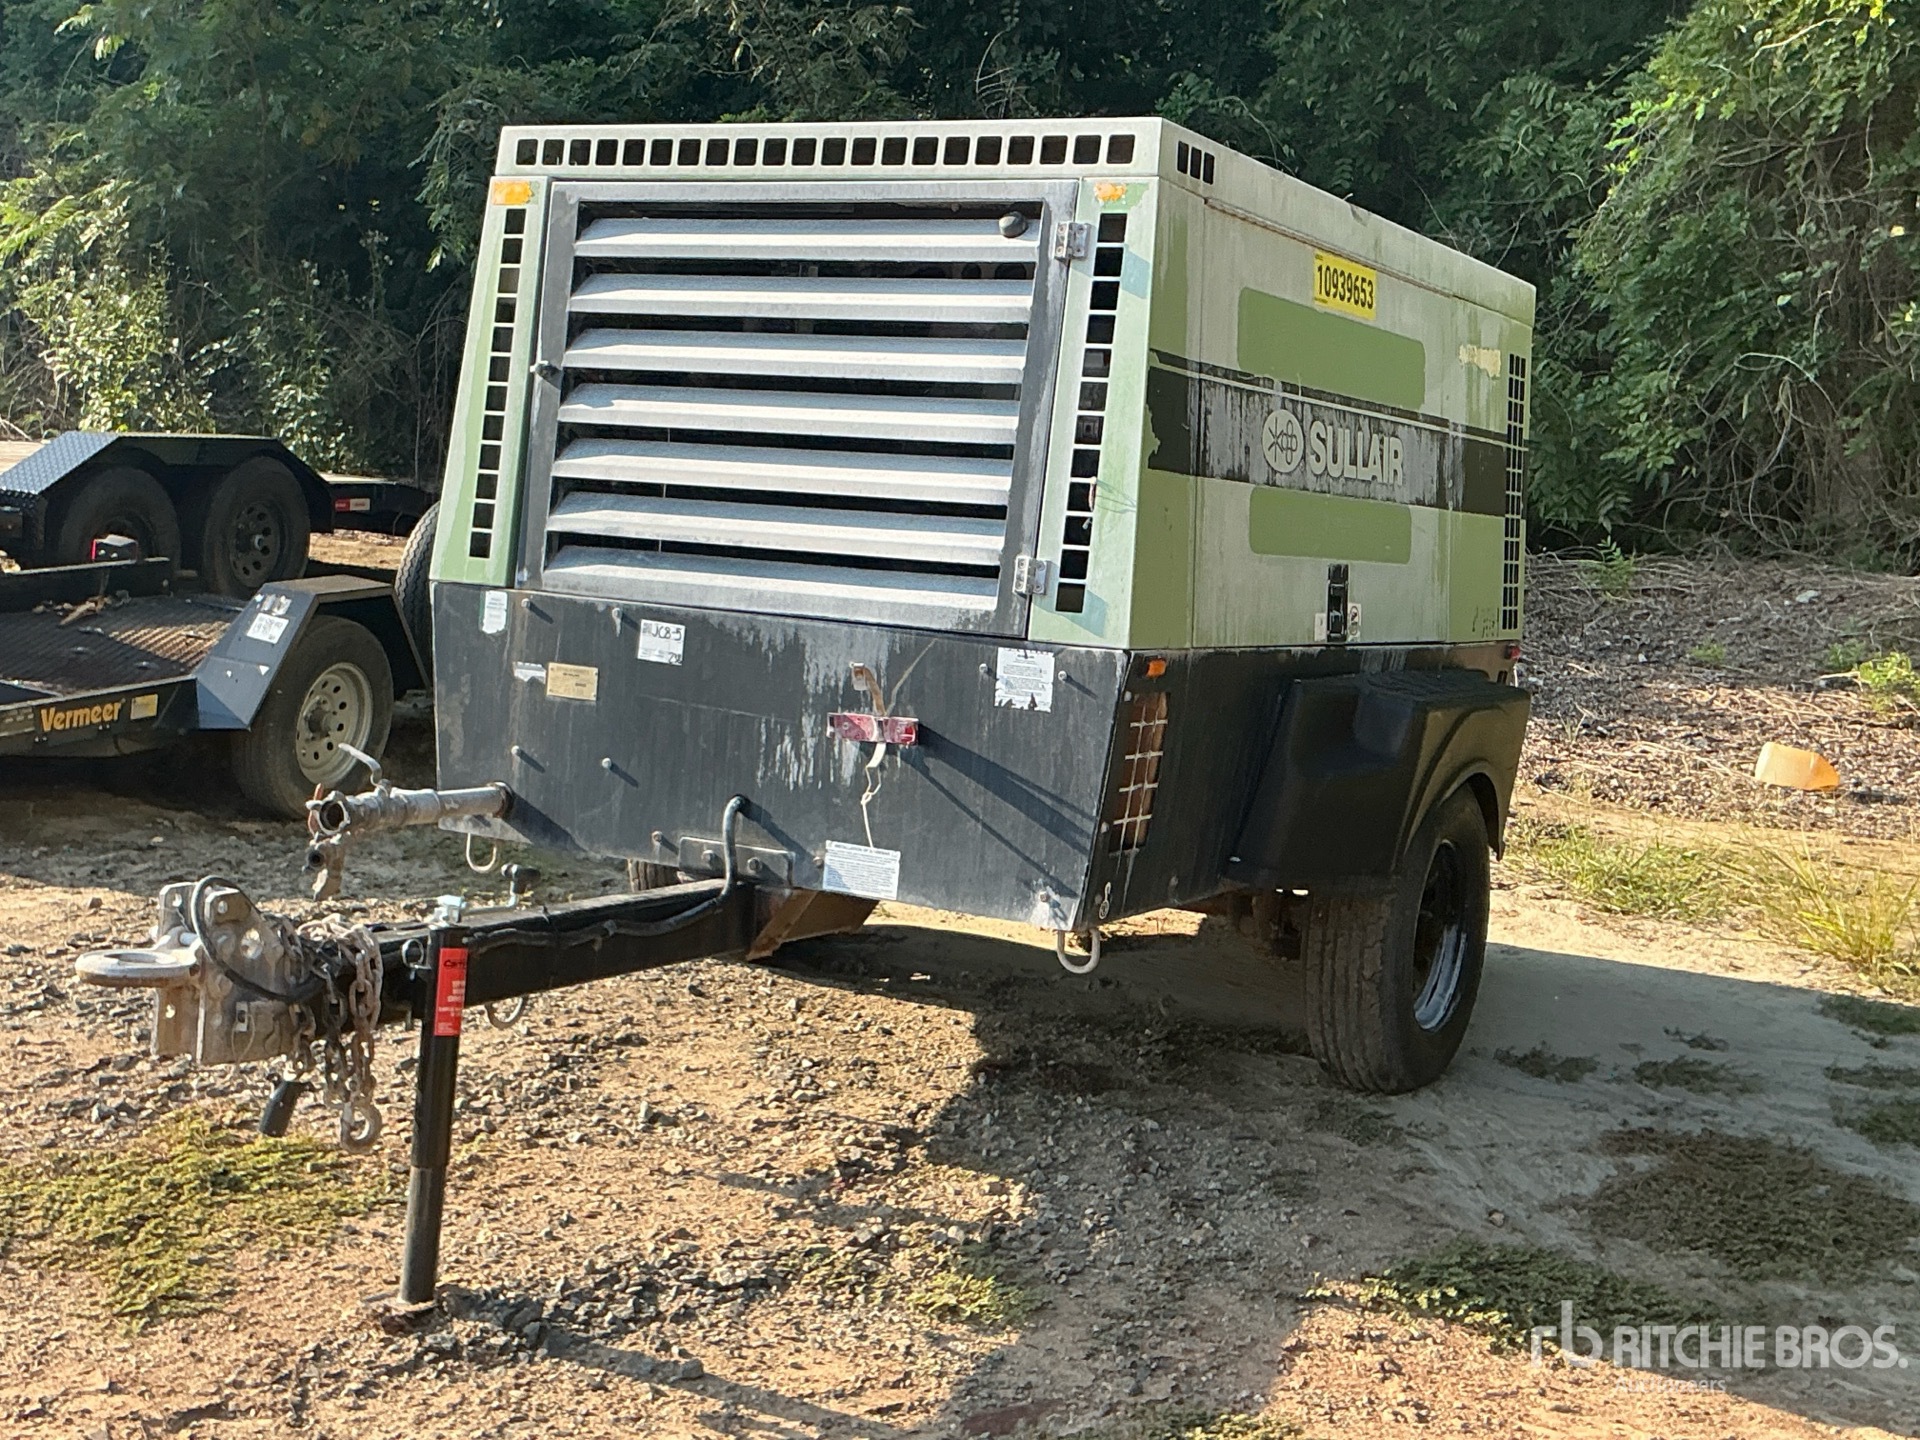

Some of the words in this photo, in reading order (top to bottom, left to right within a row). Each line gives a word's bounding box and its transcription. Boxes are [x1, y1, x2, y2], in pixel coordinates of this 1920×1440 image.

[1317, 264, 1374, 310] 10939653
[1310, 420, 1403, 485] SULLAIR
[40, 701, 122, 733] Vermeer
